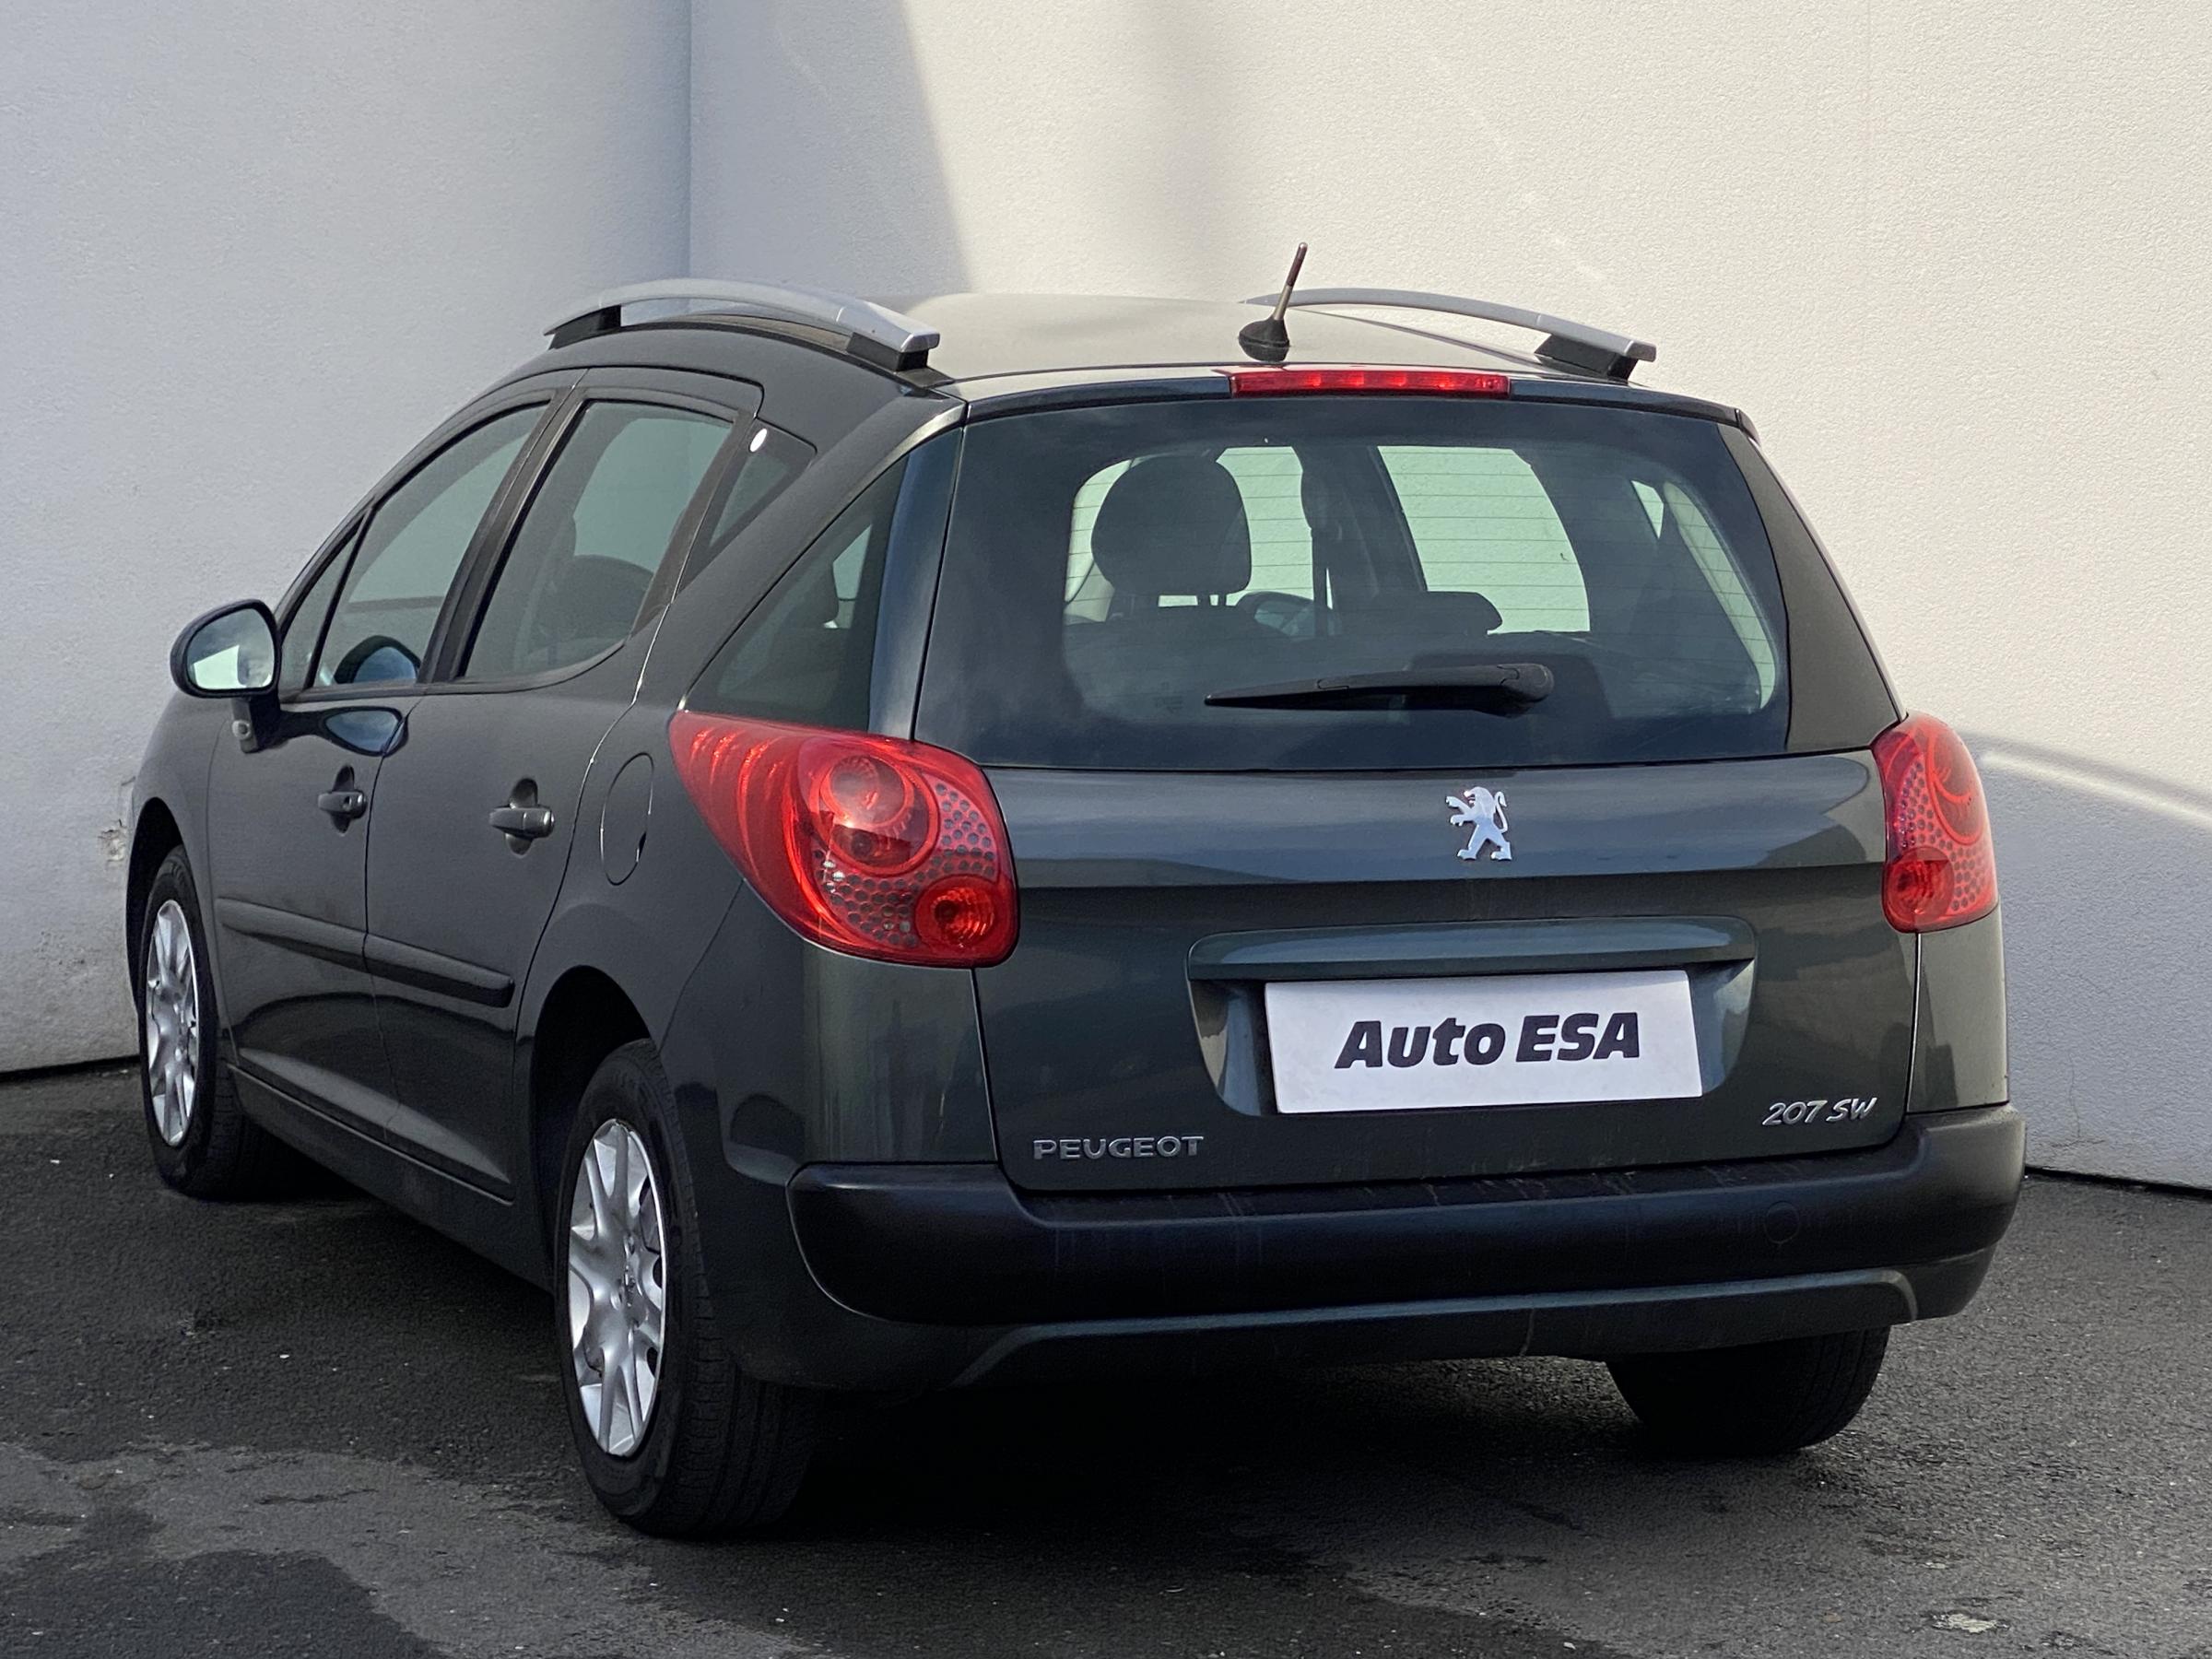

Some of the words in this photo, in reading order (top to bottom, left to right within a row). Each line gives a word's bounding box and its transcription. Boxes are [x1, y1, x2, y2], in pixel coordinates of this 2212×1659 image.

[1335, 1017, 1506, 1069] Auto
[1515, 1012, 1641, 1063] ESA
[1761, 1100, 1828, 1126] 207
[1825, 1097, 1877, 1121] SW
[1032, 1135, 1204, 1159] PEUGEOT
